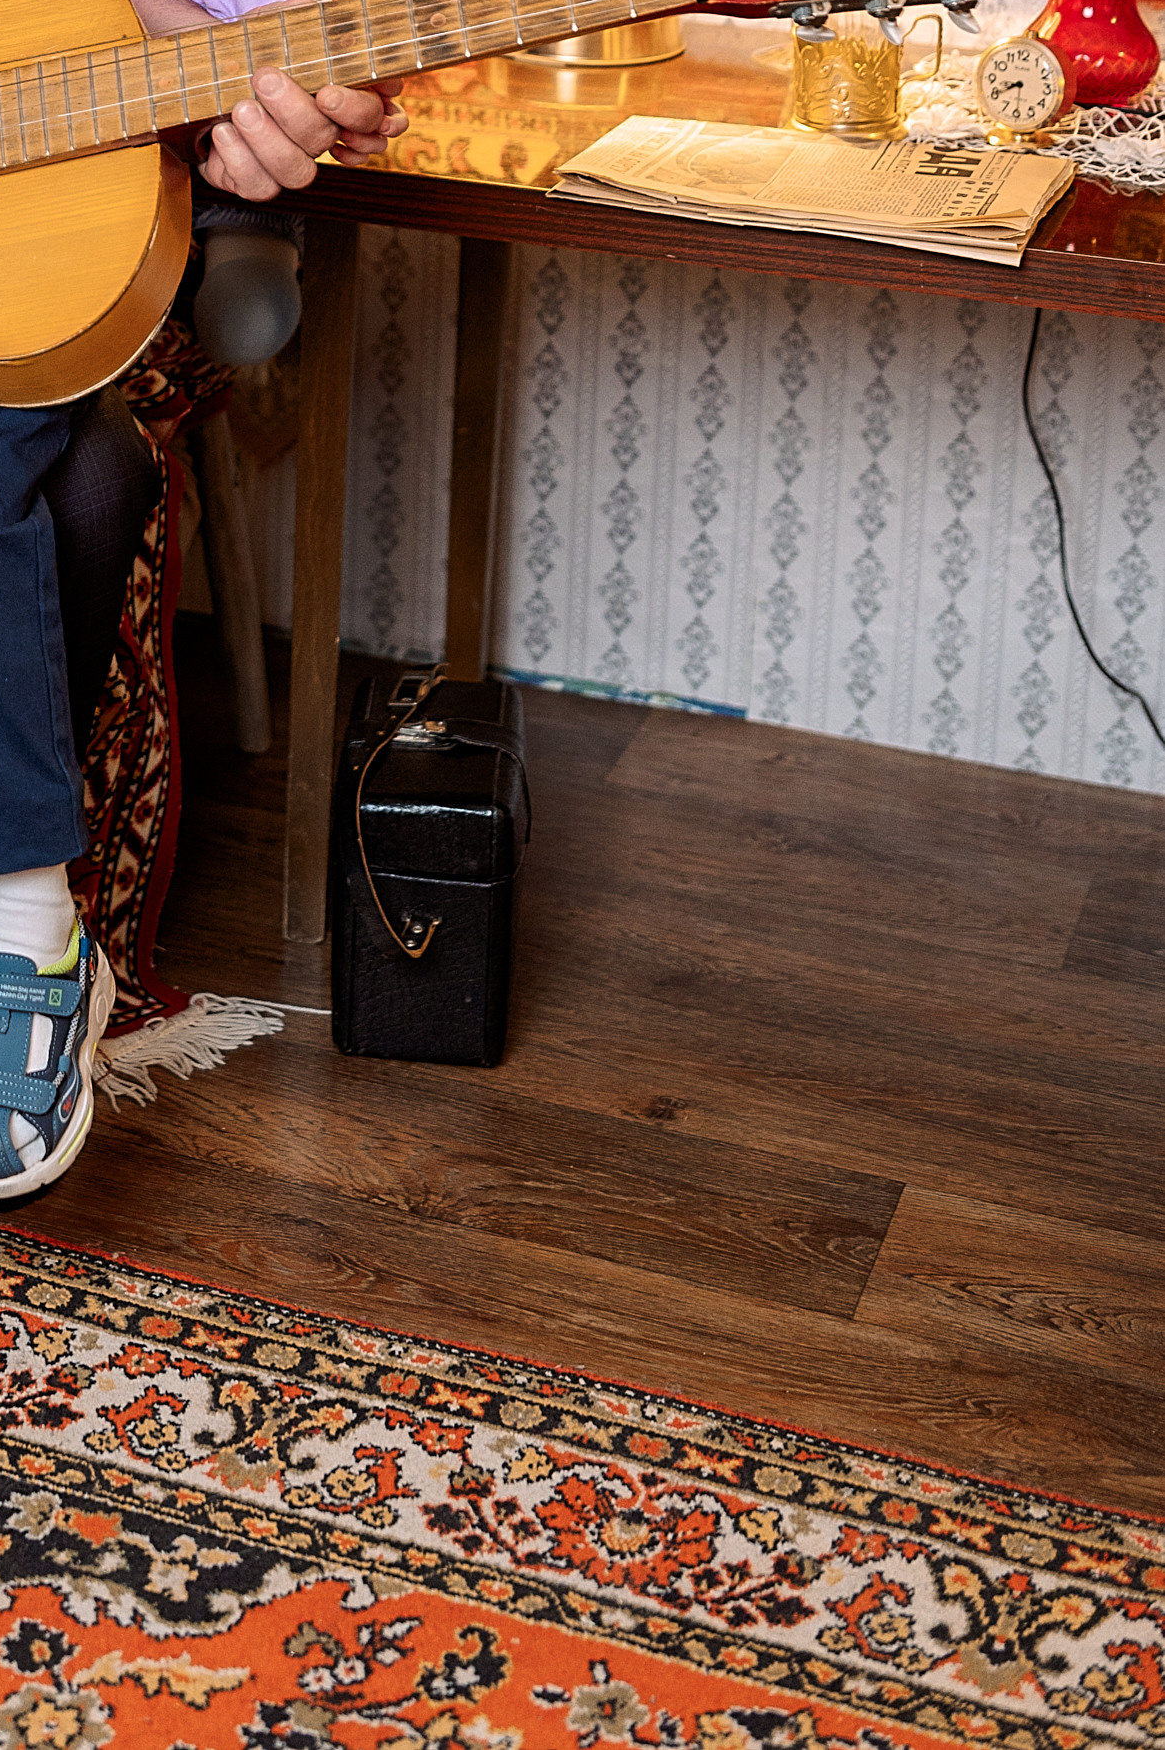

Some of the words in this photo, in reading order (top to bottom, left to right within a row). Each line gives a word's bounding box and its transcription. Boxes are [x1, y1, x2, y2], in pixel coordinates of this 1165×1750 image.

[1006, 52, 1015, 63] 11
[1017, 50, 1030, 62] 12
[994, 60, 1008, 72] 10
[1035, 57, 1039, 68] 1
[988, 73, 997, 84] 9
[1041, 68, 1051, 80] 2
[991, 87, 999, 100] 8
[1043, 82, 1052, 96] 3
[1002, 100, 1011, 112] 7
[1037, 98, 1046, 109] 4
[1012, 107, 1021, 118] 6
[1027, 106, 1035, 118] 5
